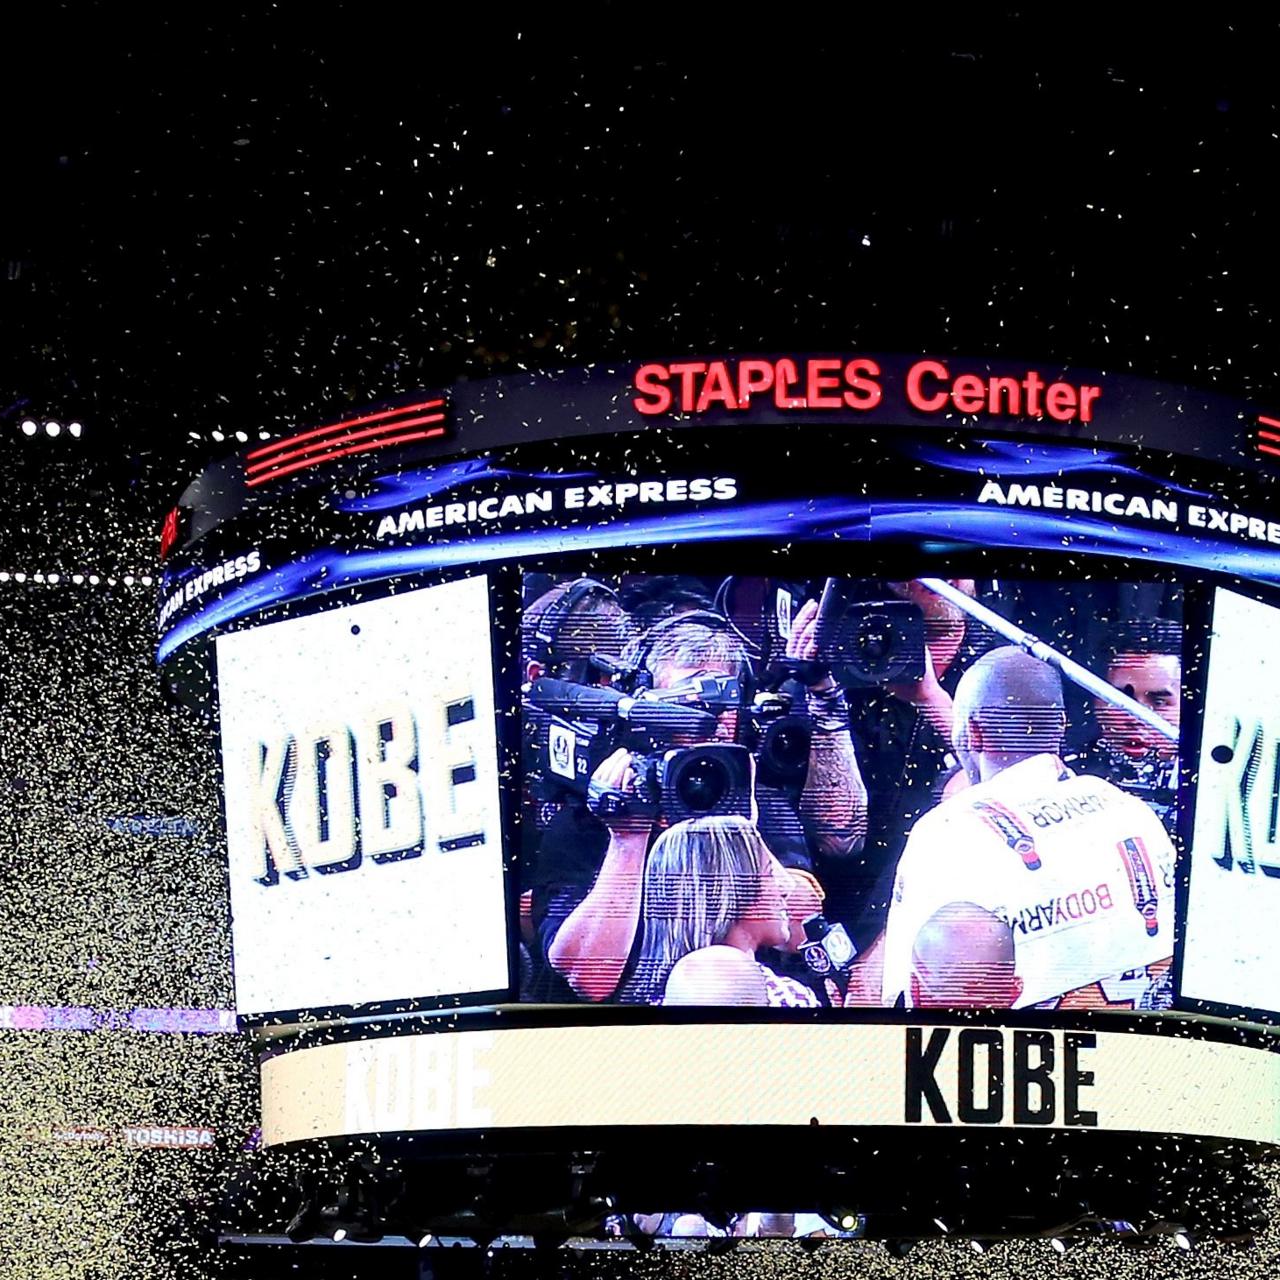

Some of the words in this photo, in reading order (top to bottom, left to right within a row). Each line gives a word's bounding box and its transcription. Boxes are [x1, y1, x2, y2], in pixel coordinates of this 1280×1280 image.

[633, 358, 882, 415] STAPLES
[906, 360, 1101, 422] Center
[375, 490, 553, 538] AMERICAN
[564, 478, 738, 508] EXPRESS
[977, 482, 1178, 523] AMERICAN
[185, 551, 261, 601] EXPRESS
[254, 693, 487, 887] KOBE
[344, 1033, 494, 1132] KOBE
[905, 1027, 1098, 1127] KOBE
[124, 1126, 214, 1146] TOSHIBA
